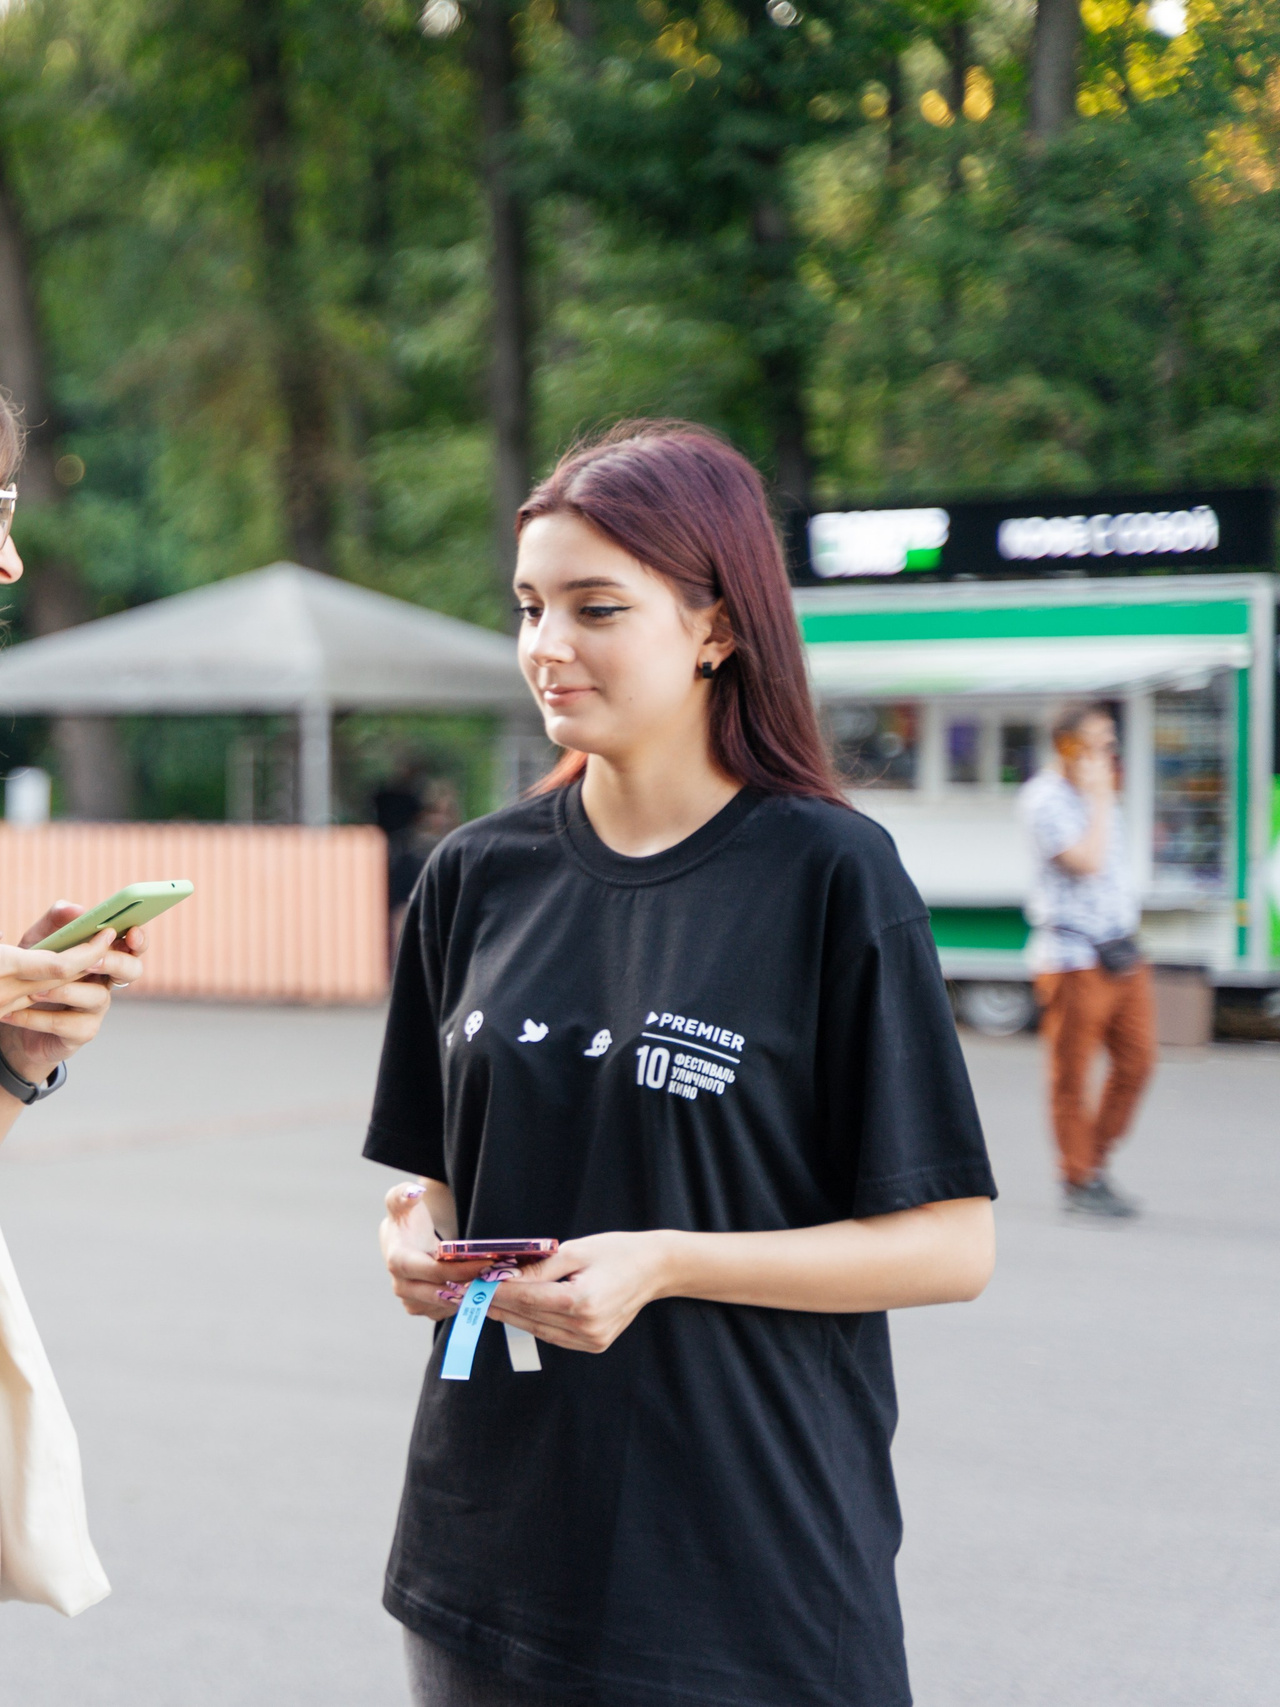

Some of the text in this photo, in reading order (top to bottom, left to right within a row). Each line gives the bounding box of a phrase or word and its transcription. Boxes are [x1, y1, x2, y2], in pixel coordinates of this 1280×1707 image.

[658, 1012, 746, 1052] PREMIER
[636, 1044, 671, 1090] 10
[671, 1065, 726, 1095] УЛИЧНОГО
[673, 1052, 736, 1084] ФЕСТИВАЛЬ
[667, 1080, 699, 1100] КИНО
